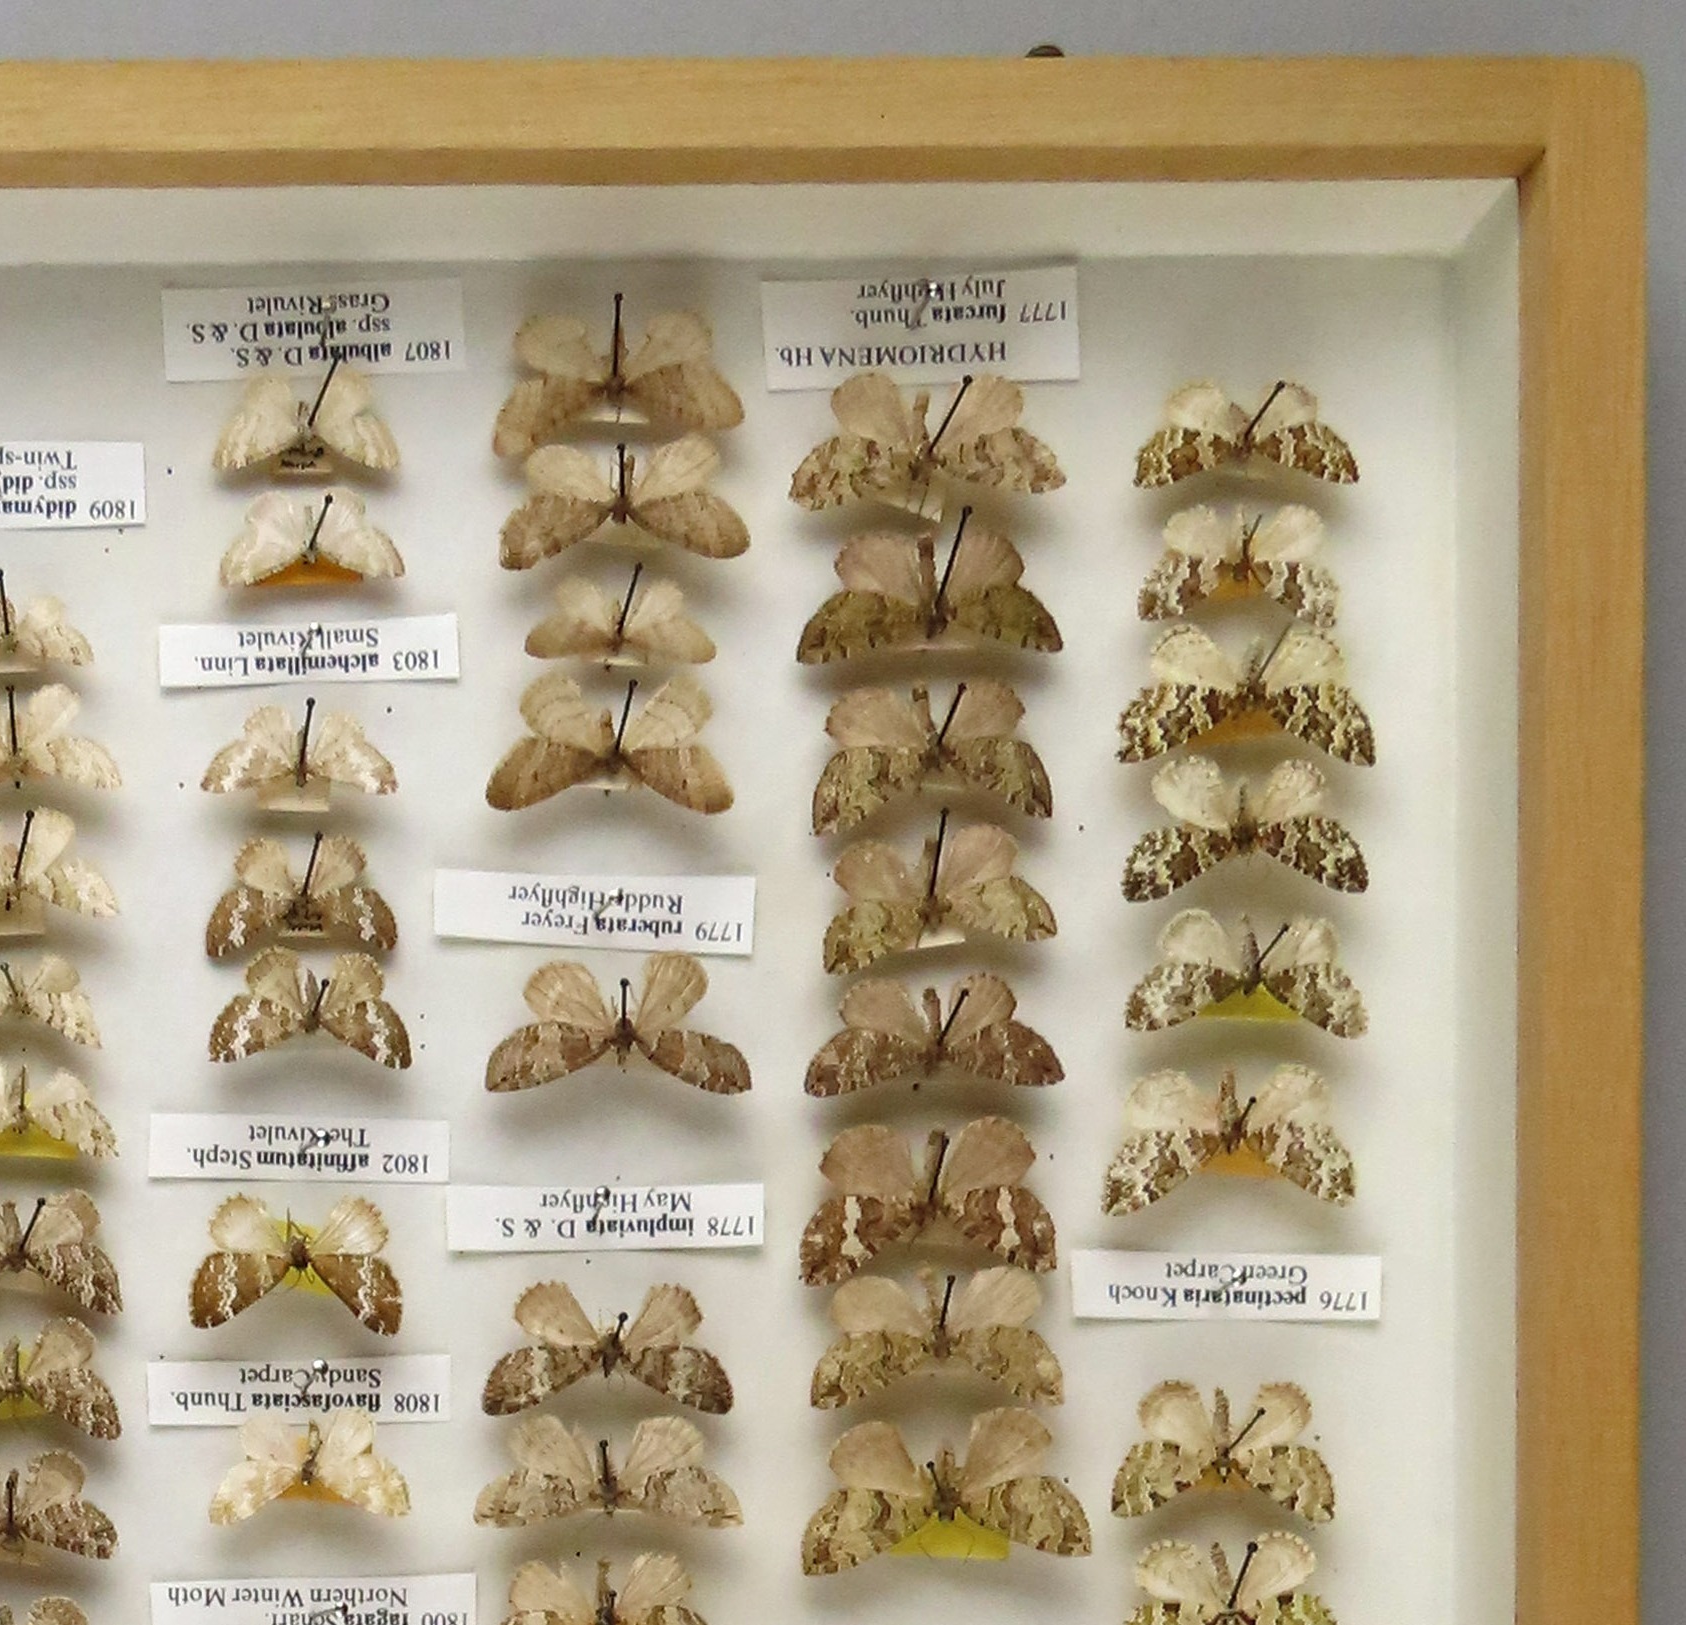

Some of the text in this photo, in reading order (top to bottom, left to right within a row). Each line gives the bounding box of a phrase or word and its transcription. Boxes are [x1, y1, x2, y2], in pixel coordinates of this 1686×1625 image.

[932, 301, 1065, 323] 1777 furcata
[405, 340, 449, 361] 1807
[776, 341, 1005, 366] HYDRIOMENA Hb.
[89, 500, 134, 519] 1809
[195, 650, 438, 676] 1803 alchemillata Linn.
[522, 909, 742, 941] 1779 Freyer
[188, 1144, 428, 1174] 1802 affinitatum Steph.
[644, 1188, 691, 1212] May
[586, 1211, 753, 1238] 1778 impluviata
[1109, 1285, 1367, 1311] 1776 Knoch
[239, 1364, 315, 1391] Carpet
[171, 1392, 439, 1413] 1808 Thunb.
[169, 1588, 407, 1608] Northern Winter Moth
